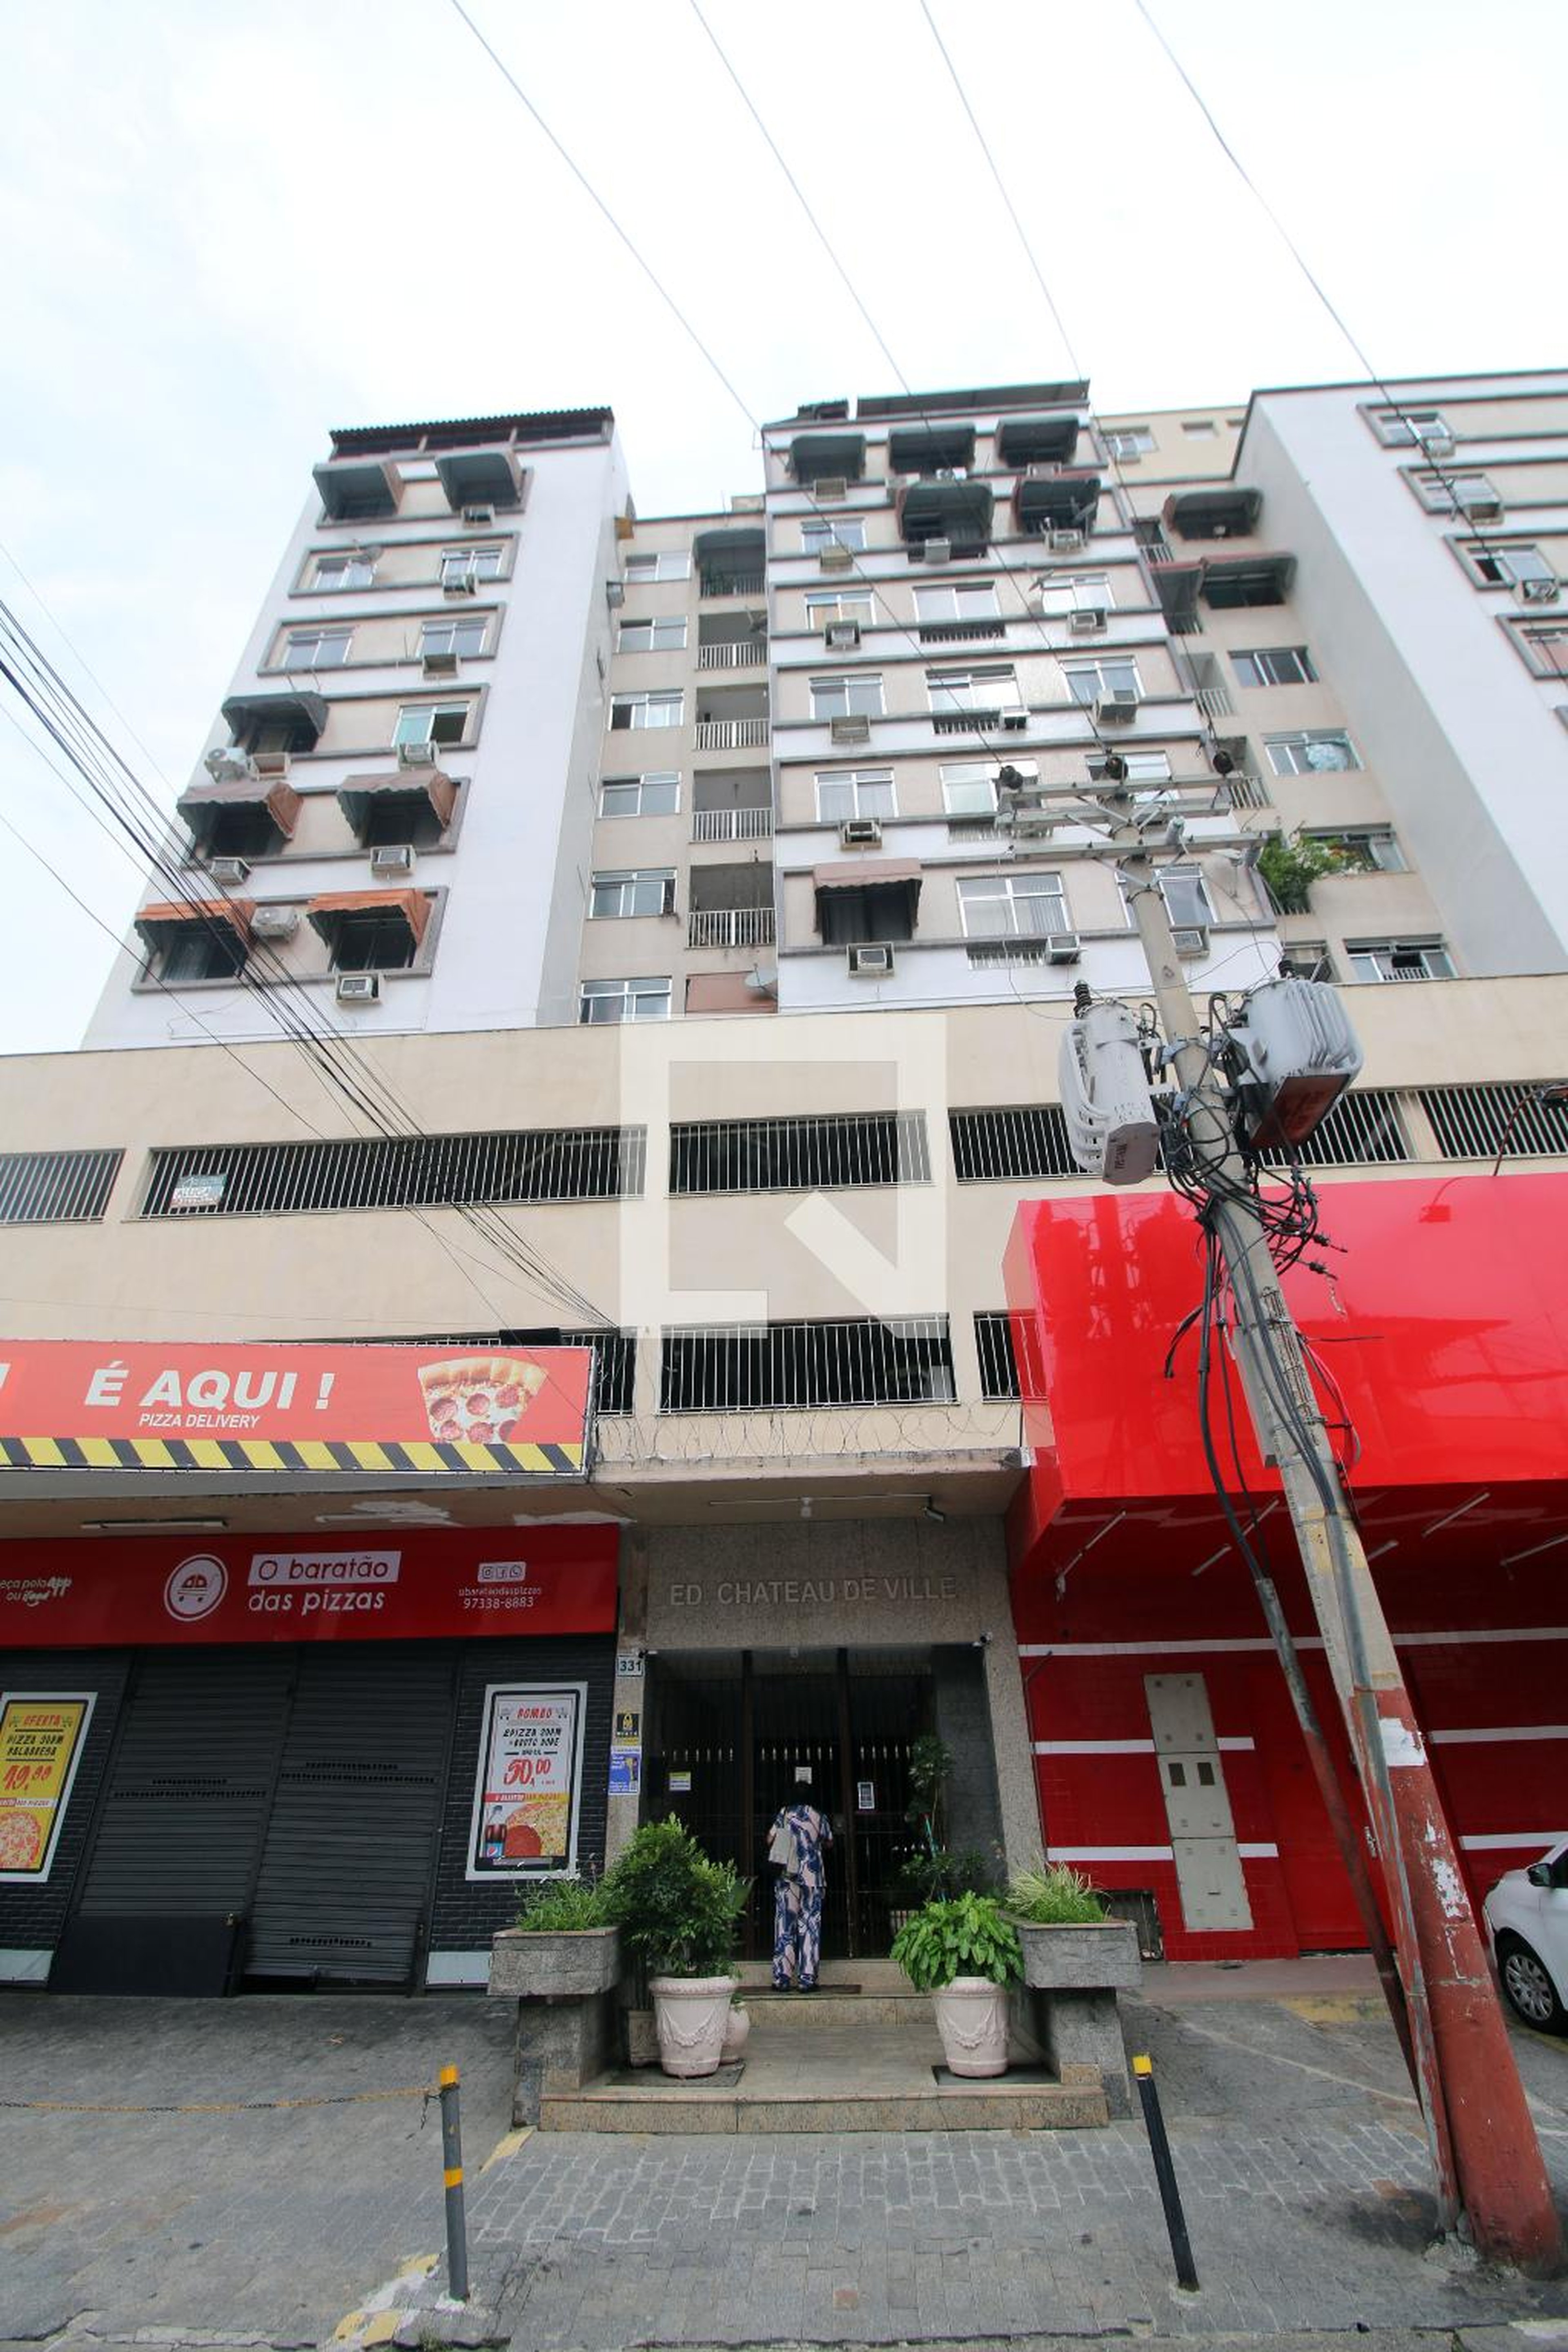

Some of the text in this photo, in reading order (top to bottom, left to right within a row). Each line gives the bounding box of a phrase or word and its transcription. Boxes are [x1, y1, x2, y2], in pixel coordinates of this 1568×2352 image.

[84, 1361, 128, 1406] É
[139, 1370, 297, 1410] AQUI
[139, 1414, 260, 1428] PIZZA DELIVERY
[258, 1556, 388, 1580] O baratão
[6, 1592, 21, 1601] ou
[248, 1588, 385, 1616] das pizzas
[717, 1580, 835, 1605] CHATEAU
[842, 1578, 878, 1601] DE
[882, 1577, 957, 1600] VILLE
[619, 1661, 642, 1672] 331
